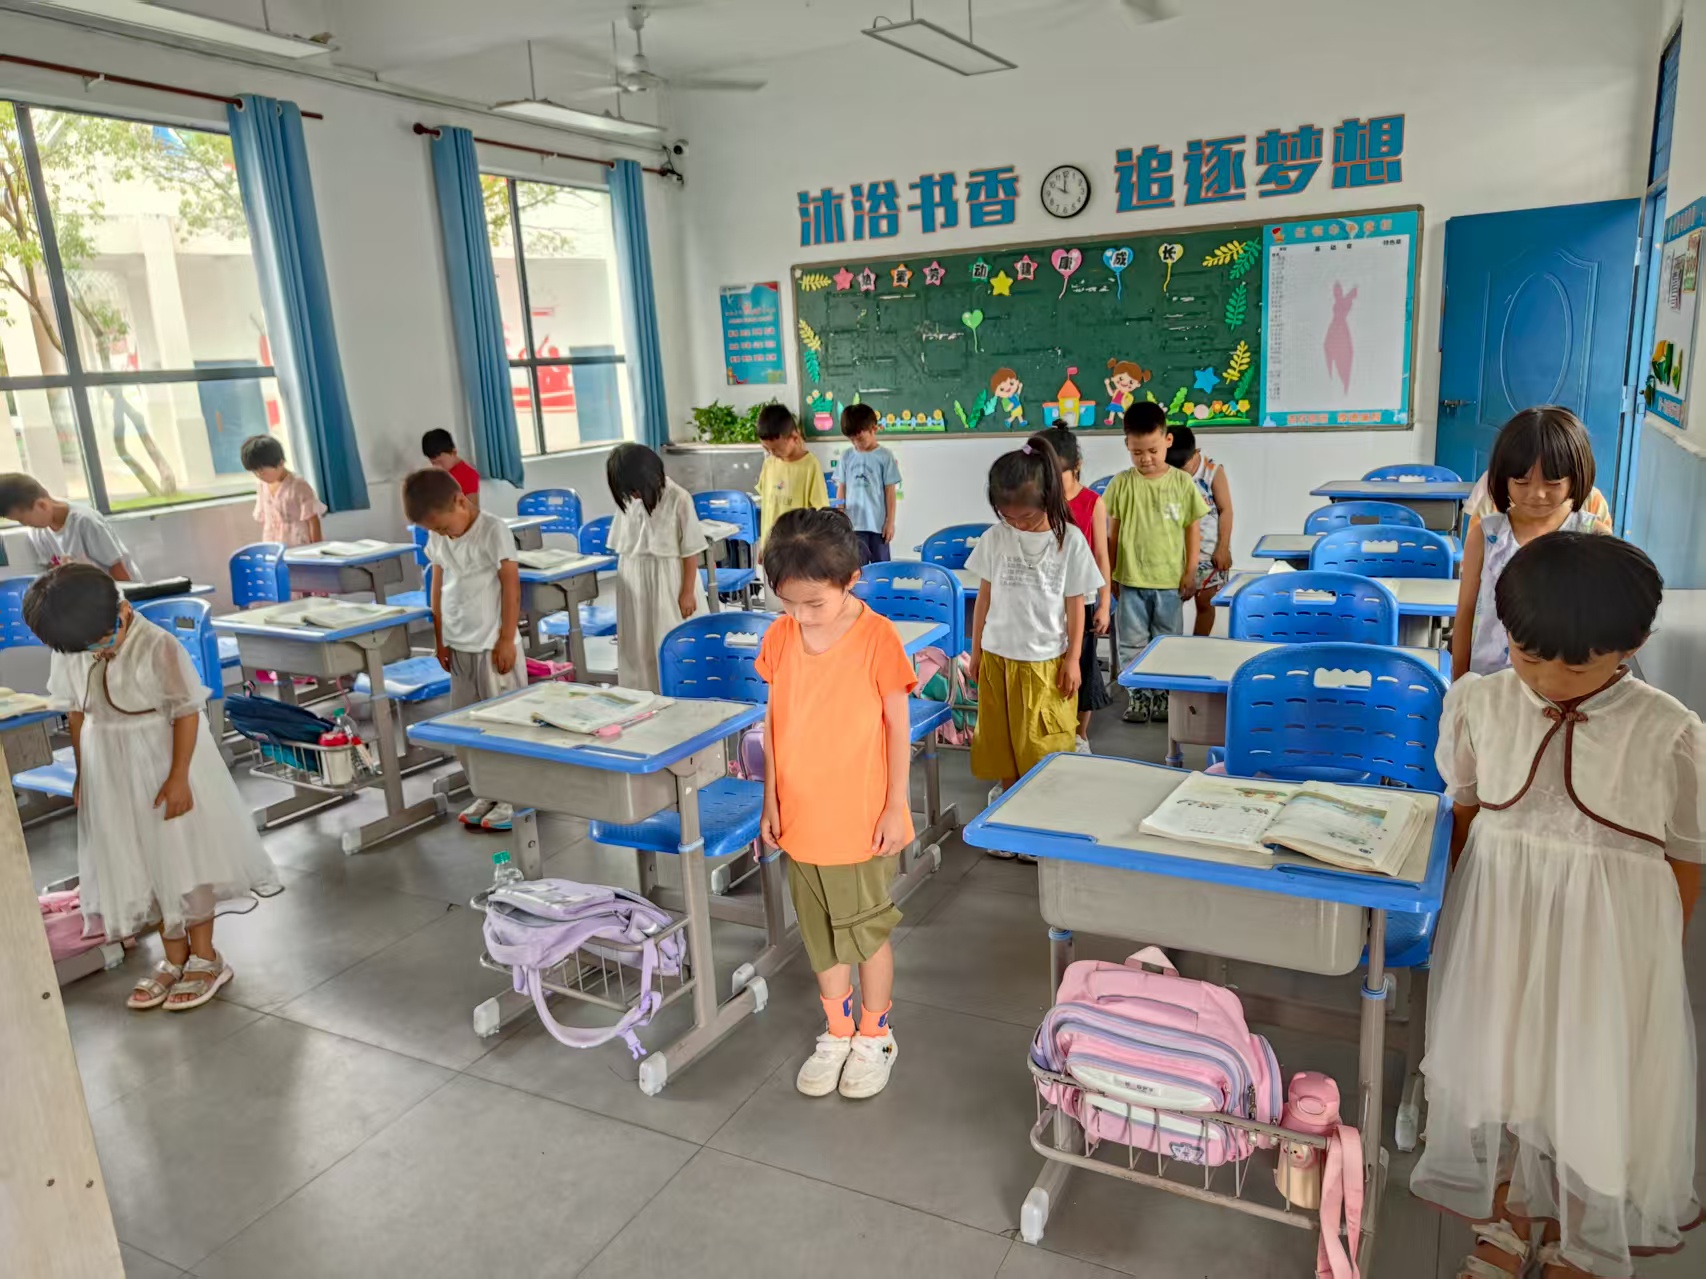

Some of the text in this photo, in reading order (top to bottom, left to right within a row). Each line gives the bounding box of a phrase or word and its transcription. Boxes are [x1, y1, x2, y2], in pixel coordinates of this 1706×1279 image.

[797, 165, 1019, 247] 沐浴书香
[1114, 114, 1405, 213] 追逐梦想
